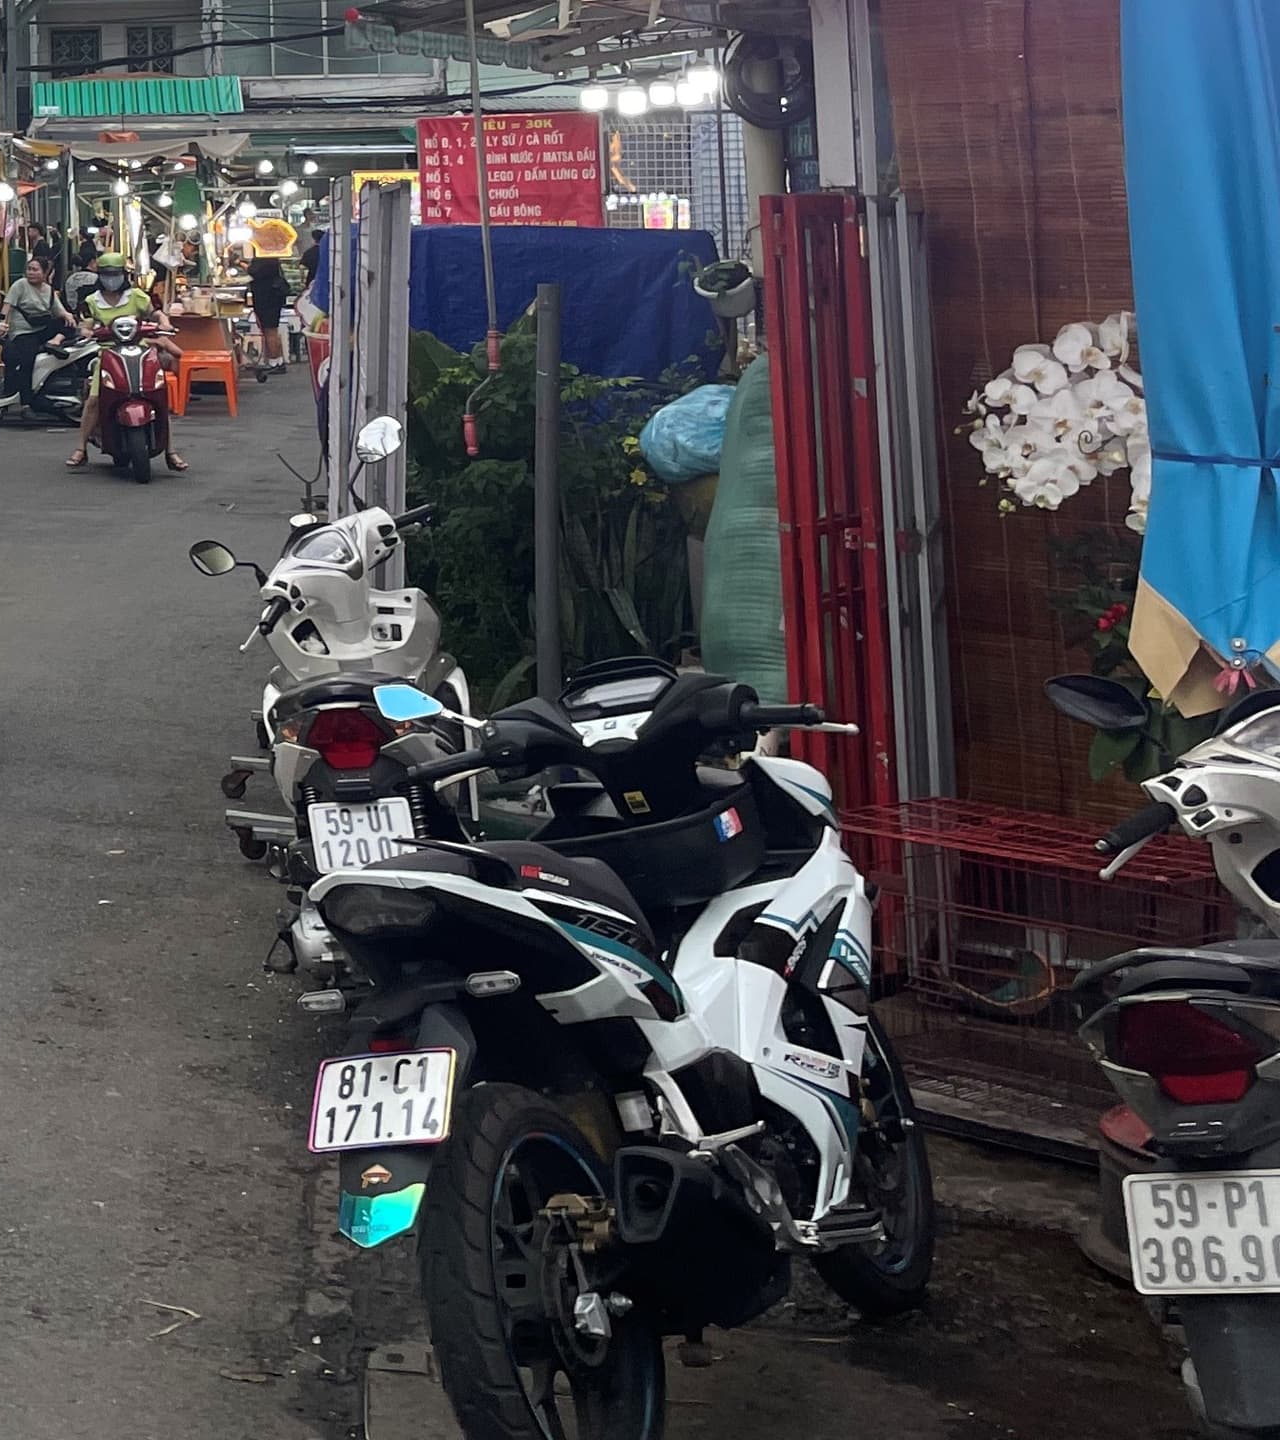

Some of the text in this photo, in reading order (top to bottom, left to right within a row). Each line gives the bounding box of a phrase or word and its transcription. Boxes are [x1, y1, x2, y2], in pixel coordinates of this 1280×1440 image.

[525, 118, 553, 129] 30K
[486, 135, 498, 147] LY
[526, 132, 540, 145] CÀ
[456, 154, 464, 165] 4
[487, 171, 514, 182] LEGO
[444, 190, 452, 200] 6
[444, 207, 452, 217] 7
[325, 804, 394, 836] 59-U1
[337, 1056, 429, 1100] 81-C1
[325, 1096, 440, 1144] 171.14
[1150, 1180, 1270, 1230] 59-P1
